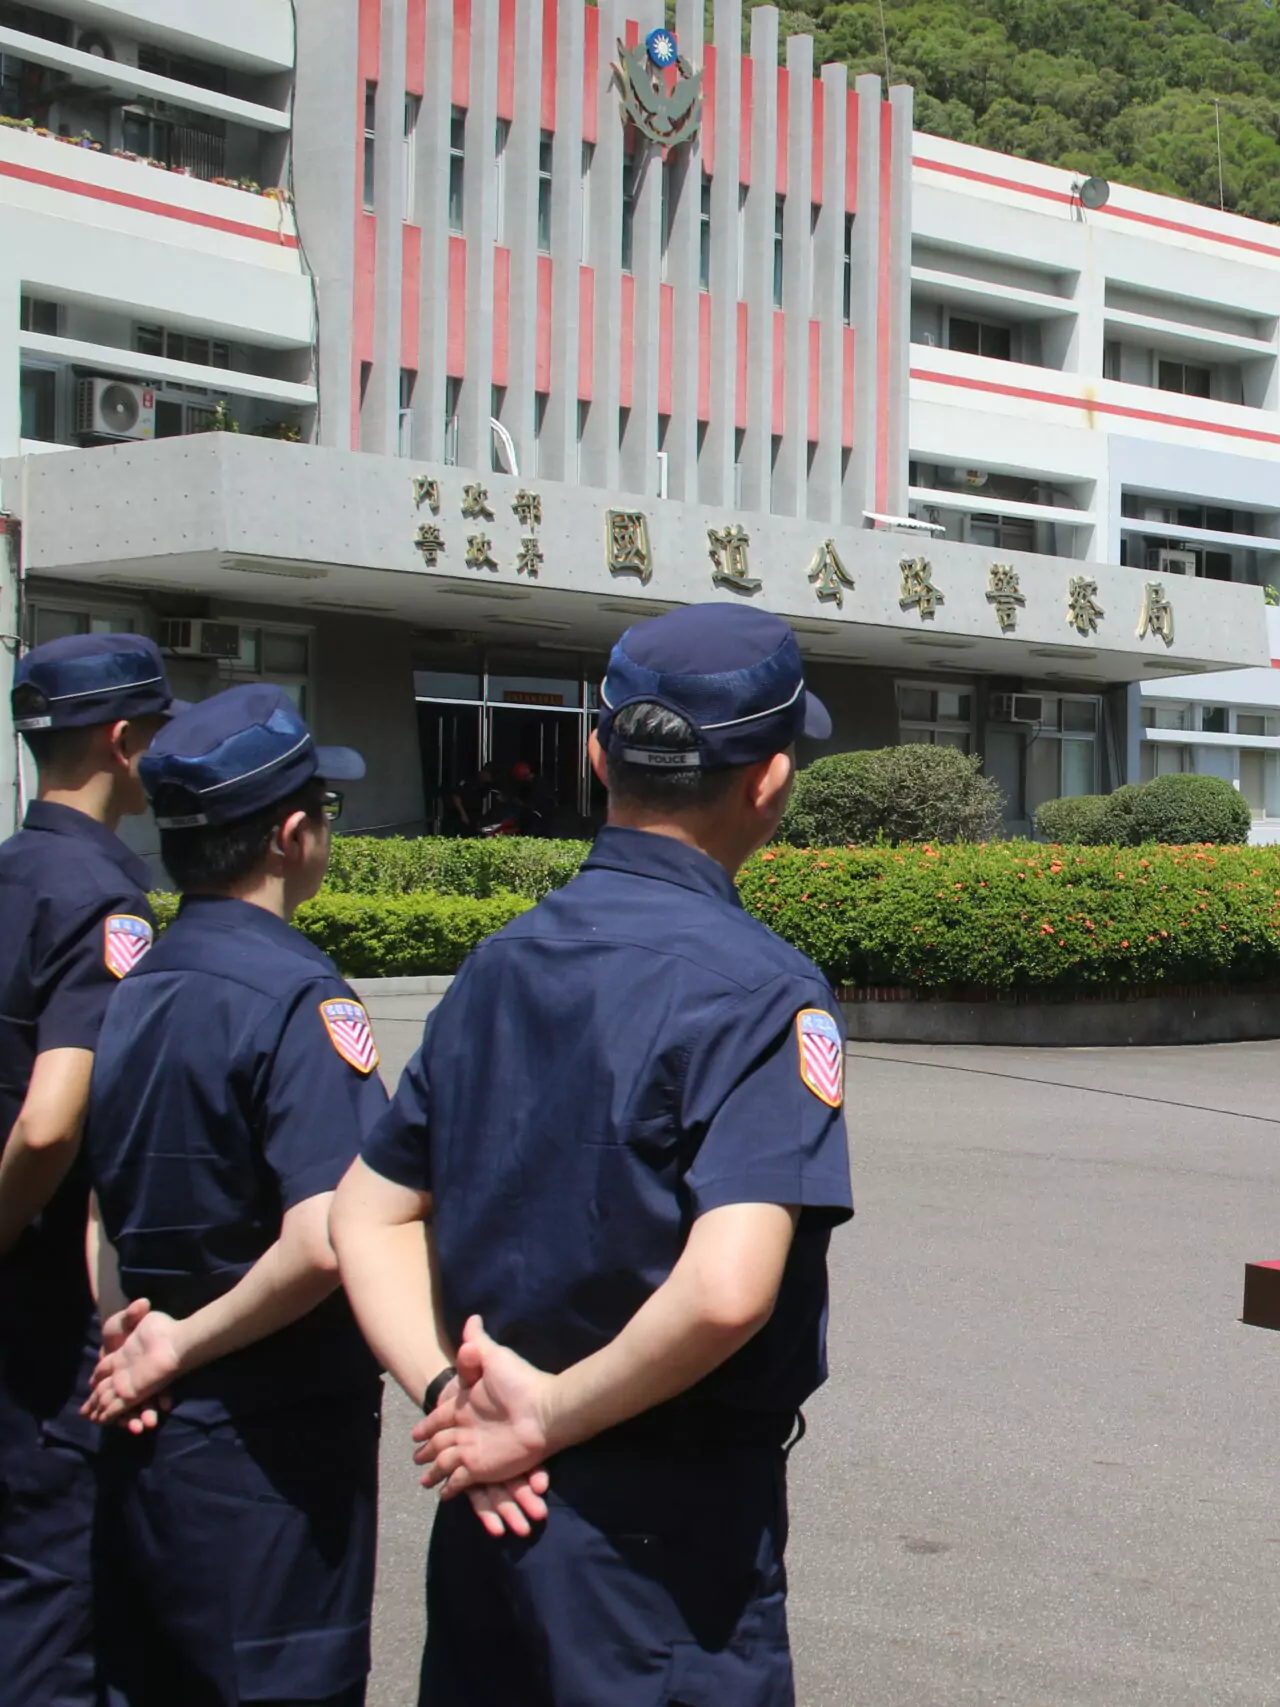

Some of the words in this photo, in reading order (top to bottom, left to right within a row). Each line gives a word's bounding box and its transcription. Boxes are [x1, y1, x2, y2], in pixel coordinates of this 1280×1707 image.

[413, 523, 544, 578] 警政署
[605, 508, 1175, 646] 國道公路警察局
[647, 754, 687, 765] POLICE
